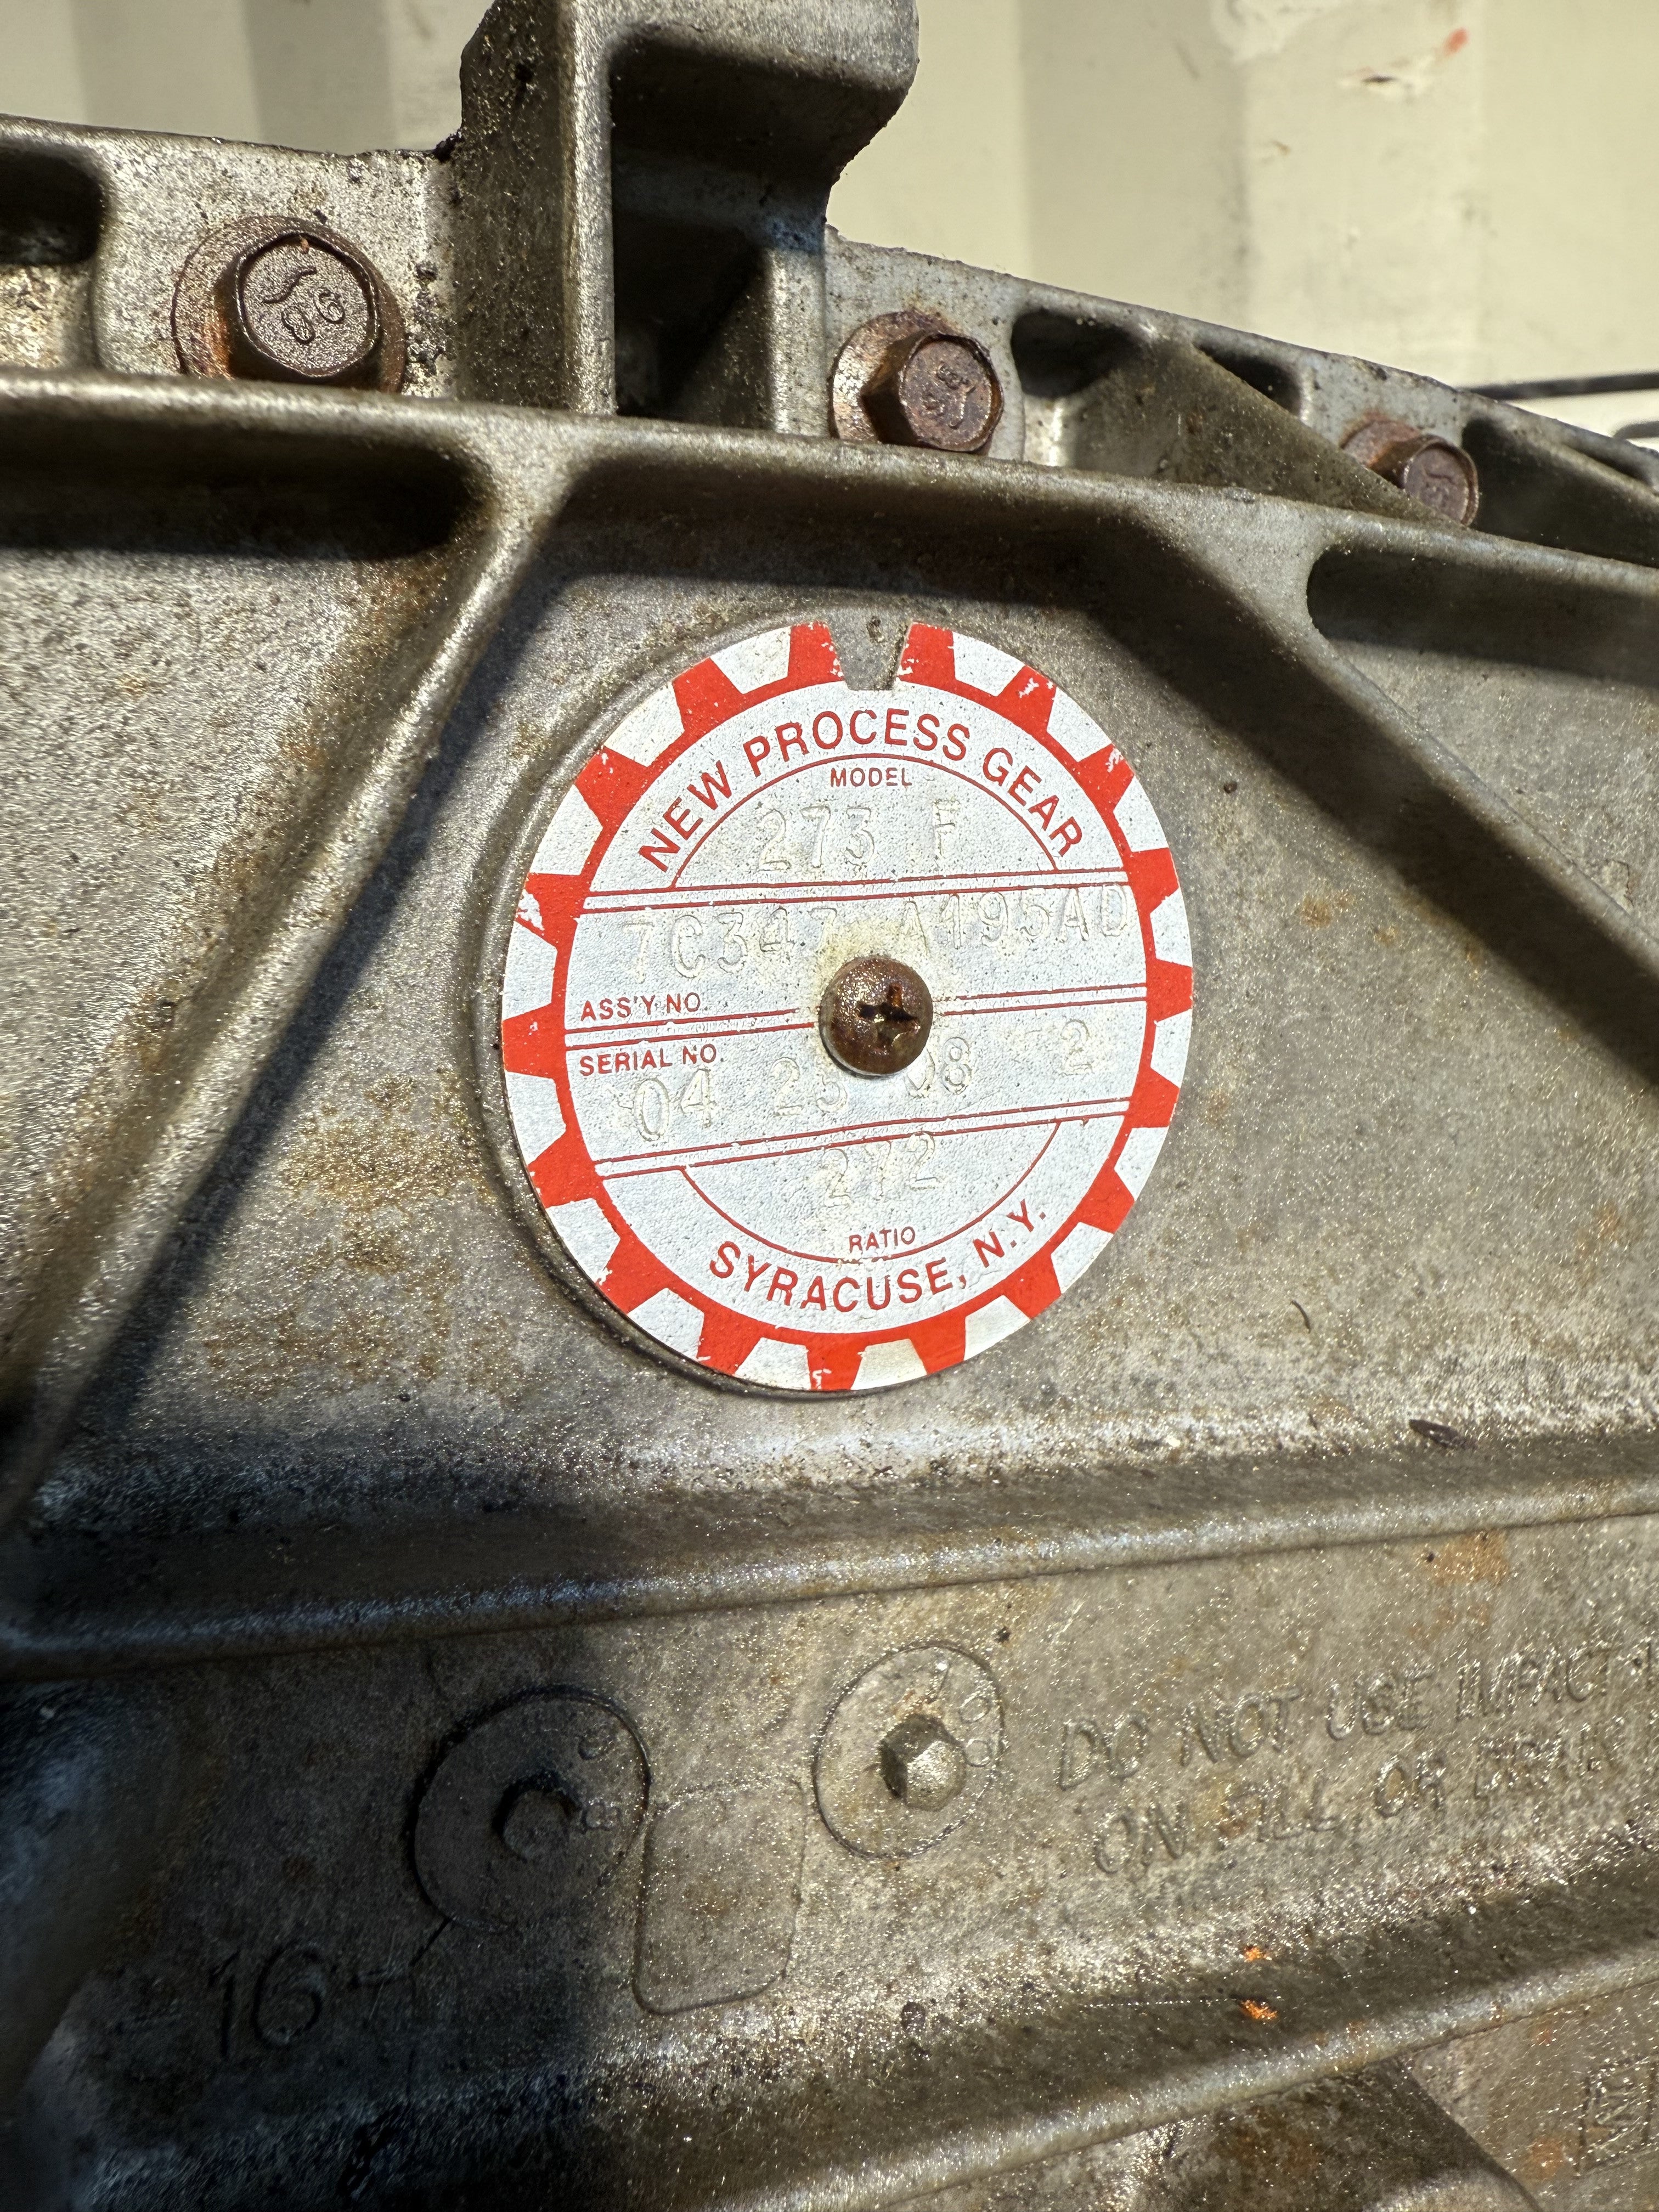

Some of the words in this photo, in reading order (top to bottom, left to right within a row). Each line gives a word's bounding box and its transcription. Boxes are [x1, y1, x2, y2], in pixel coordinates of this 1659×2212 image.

[637, 759, 733, 873] NEW
[743, 709, 971, 778] PROCESS
[983, 747, 1084, 858] GEAR
[830, 767, 912, 788] MODEL
[757, 804, 876, 872] 273
[932, 798, 961, 861] F
[580, 994, 656, 1022] ASS'Y
[579, 1047, 674, 1076] SERIAL
[634, 1068, 717, 1142] 04
[709, 1240, 968, 1313] SYRACUSE,
[972, 1198, 1047, 1268] N.Y.
[849, 1226, 916, 1254] RATIO
[1056, 1711, 1149, 1792] DO
[1180, 1684, 1304, 1769] NOT
[1322, 1664, 1435, 1741] USE
